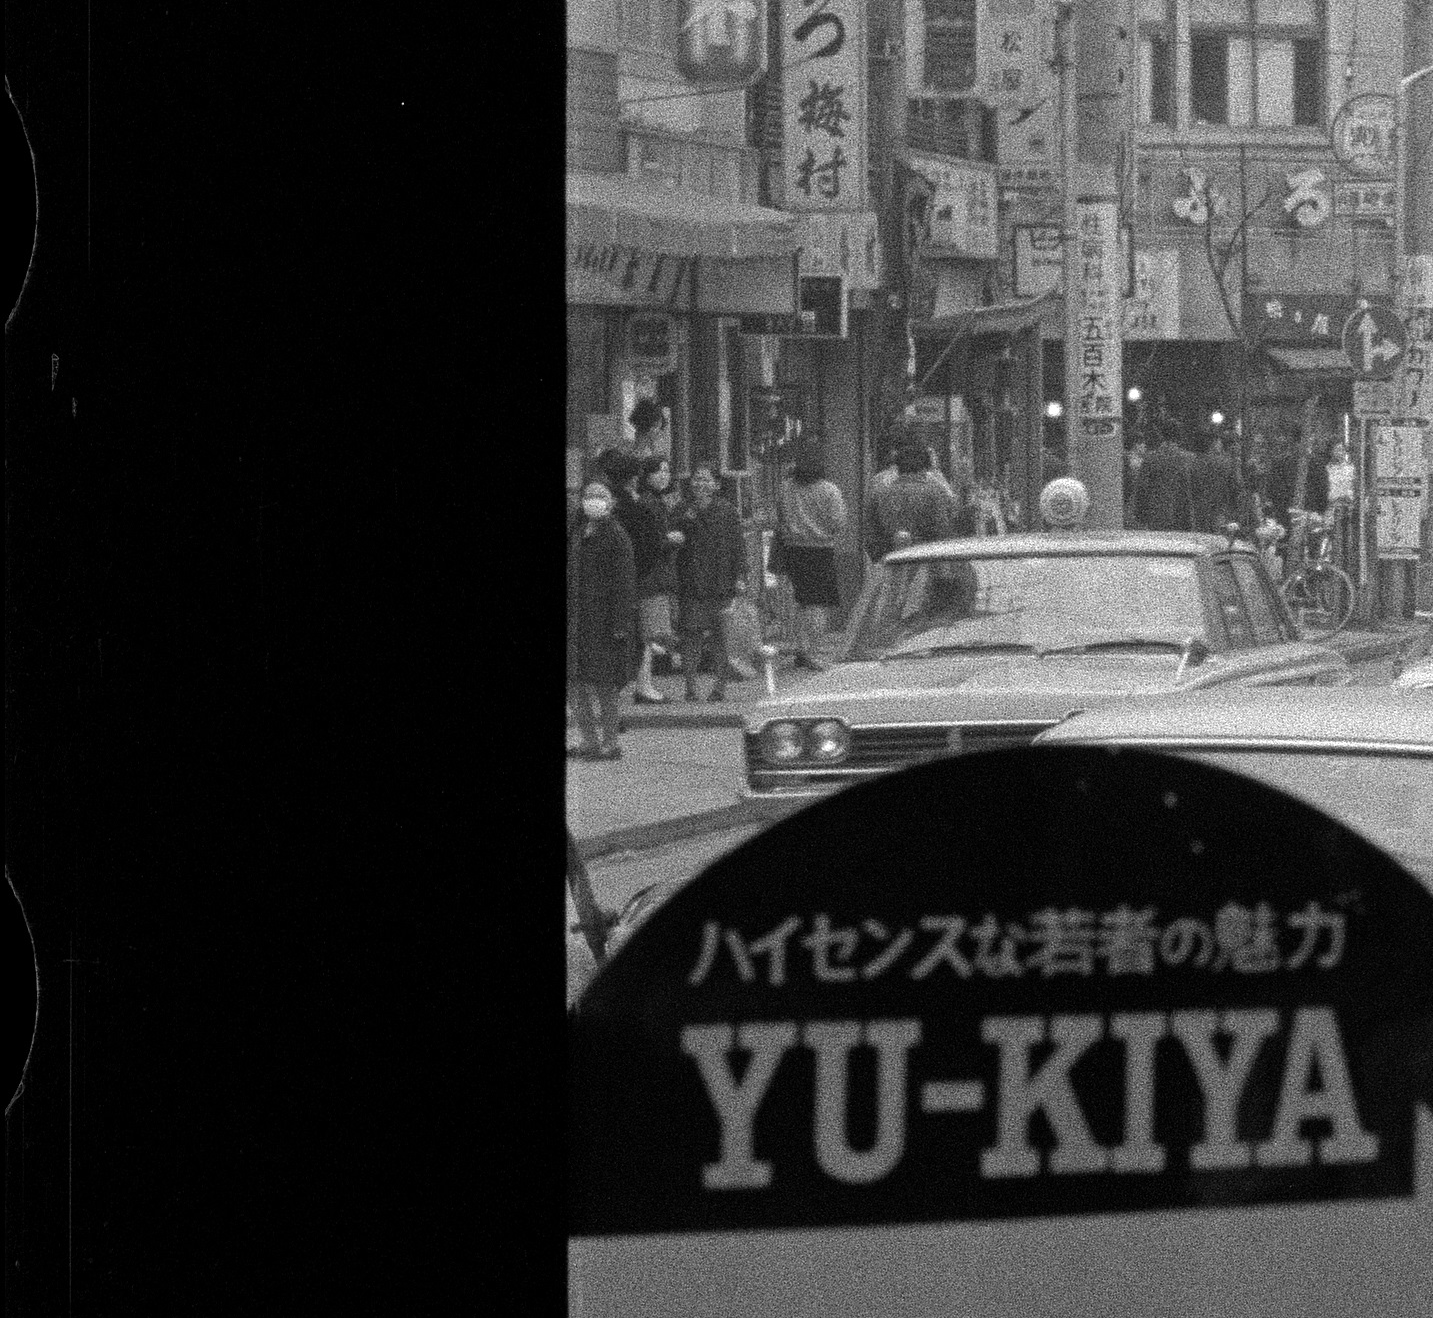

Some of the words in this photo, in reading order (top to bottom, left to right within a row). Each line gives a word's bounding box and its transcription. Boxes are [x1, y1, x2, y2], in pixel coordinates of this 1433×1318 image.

[688, 901, 1348, 986] ハイセンスな若者の魅力
[680, 1006, 1380, 1190] YU-KIYA
